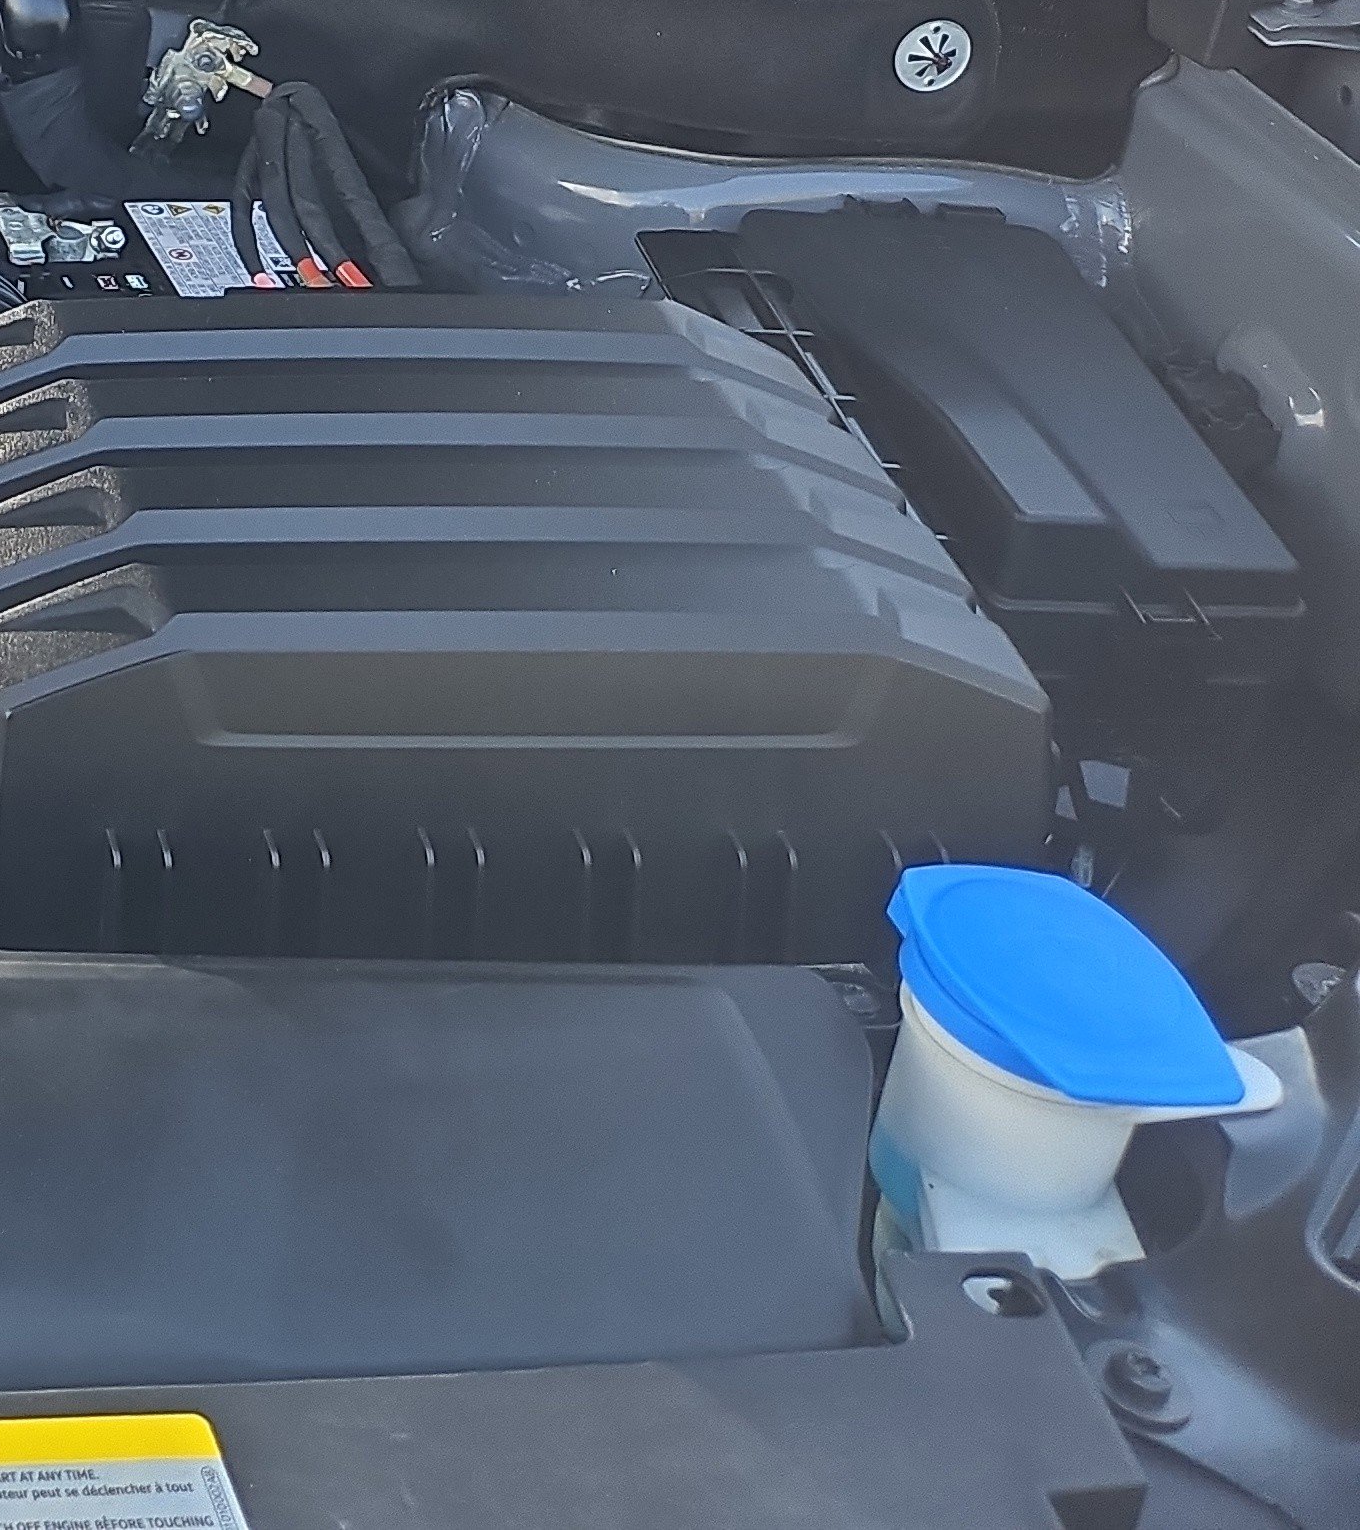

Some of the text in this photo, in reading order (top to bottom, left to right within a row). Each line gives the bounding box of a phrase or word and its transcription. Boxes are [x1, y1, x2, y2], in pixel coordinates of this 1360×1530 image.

[20, 1471, 35, 1483] AT
[37, 1470, 65, 1483] ANY
[32, 1486, 63, 1502] peut
[64, 1487, 81, 1498] se
[82, 1483, 153, 1498] déclencher
[155, 1481, 164, 1494] à
[166, 1481, 195, 1494] tout
[43, 1519, 91, 1530] ENGINE
[148, 1515, 215, 1528] TOUCHING
